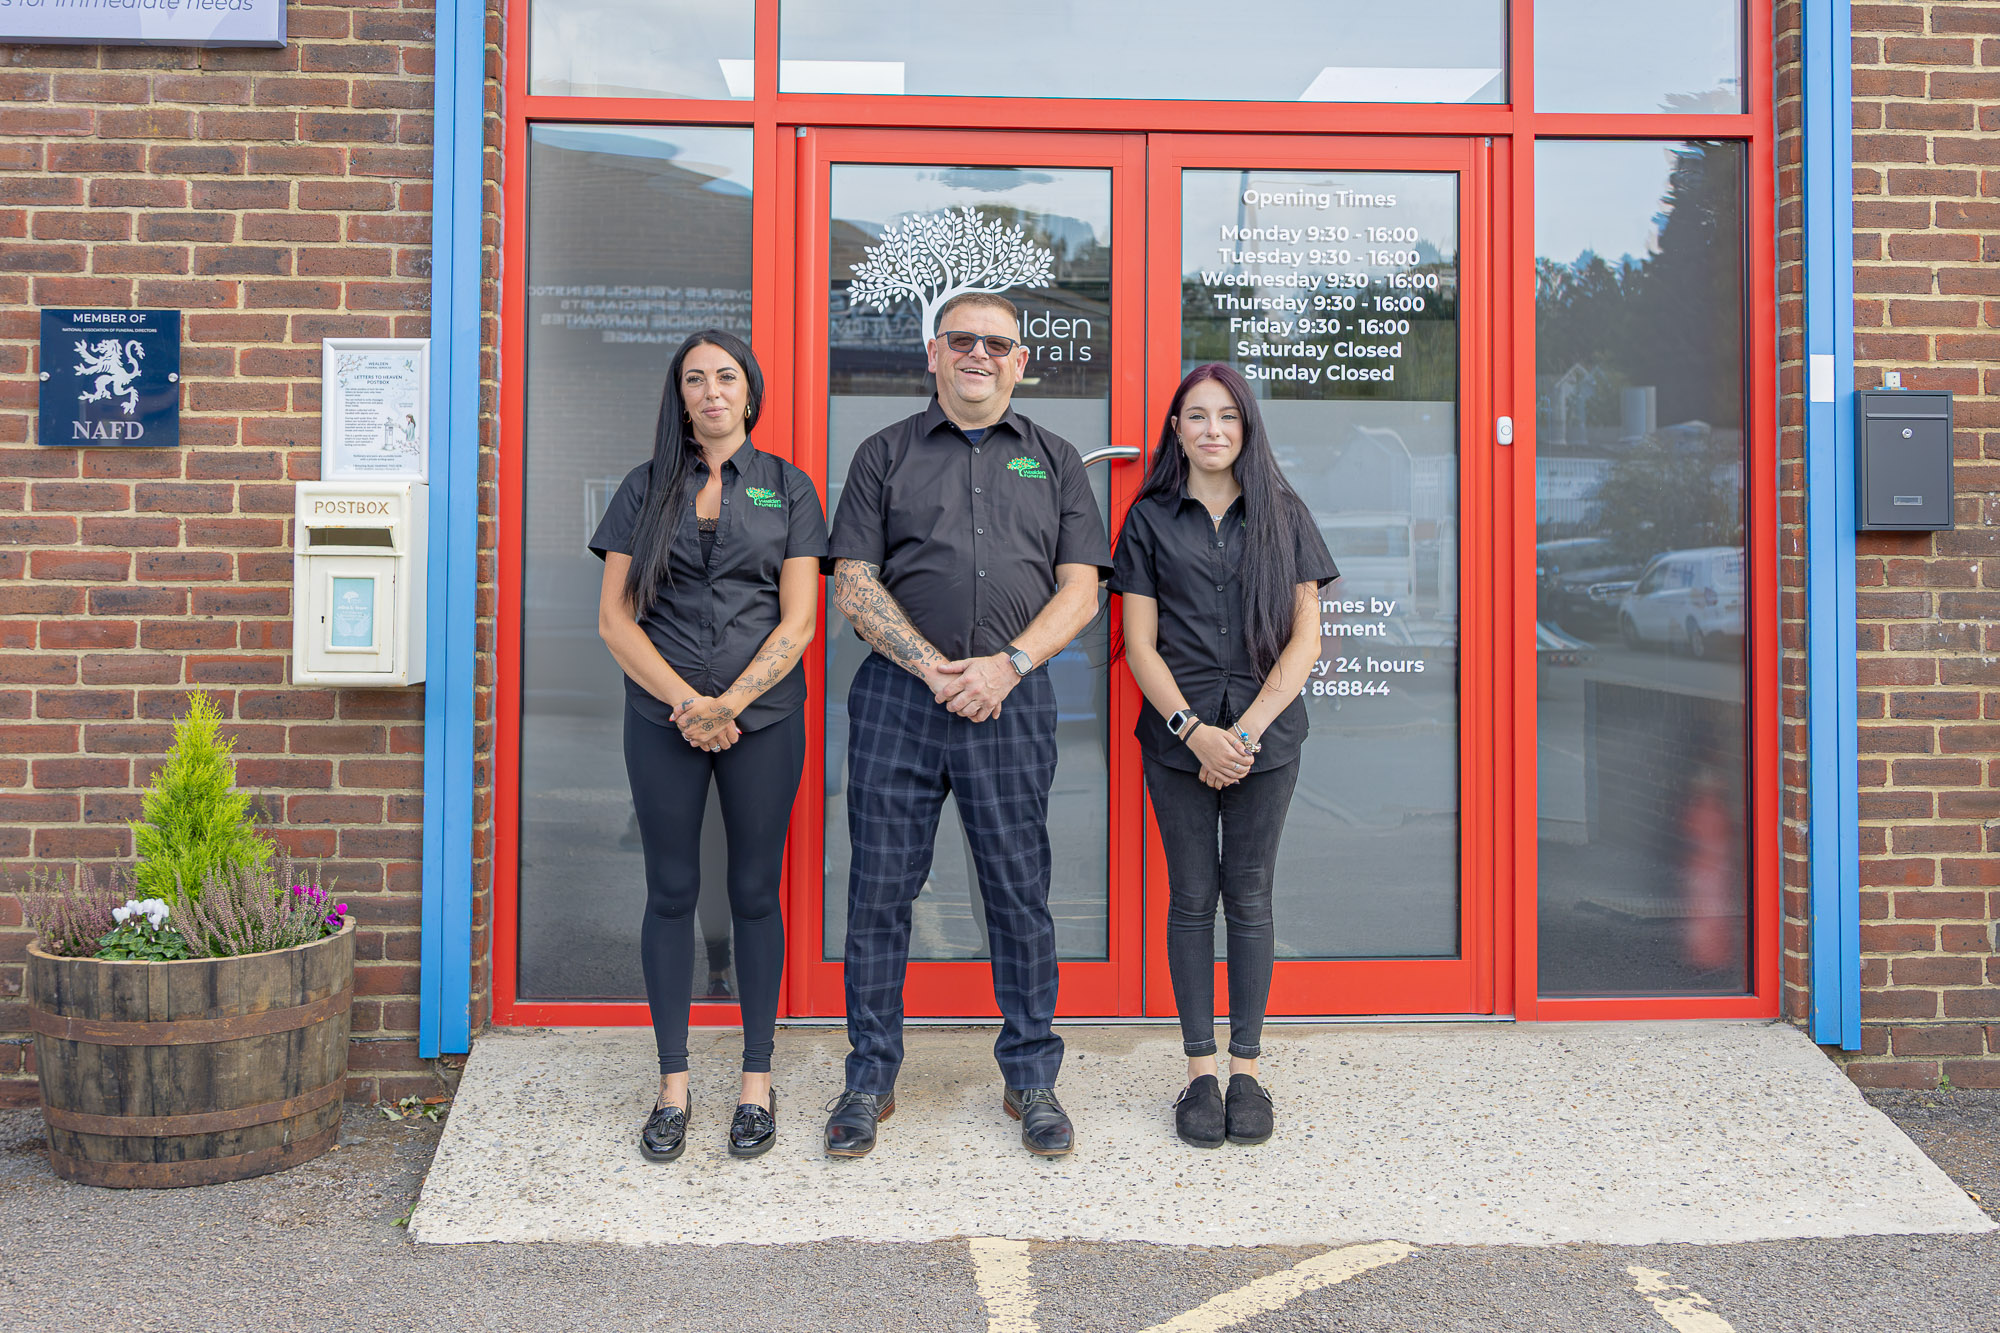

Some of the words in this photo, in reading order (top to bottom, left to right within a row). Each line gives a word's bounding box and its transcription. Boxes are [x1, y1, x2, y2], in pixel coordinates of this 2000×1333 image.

[1243, 189, 1331, 209] Opening
[1336, 190, 1397, 207] Times
[1221, 225, 1302, 244] Monday
[1308, 226, 1349, 241] 9:30
[1368, 227, 1419, 242] 16:00
[1219, 248, 1304, 267] Tuesday
[1309, 250, 1351, 264] 9:30
[1369, 250, 1421, 265] 16:00
[1201, 270, 1322, 291] Wednesday
[1327, 273, 1369, 288] 9:30
[1387, 273, 1439, 289] 16:00
[1213, 294, 1309, 314] Thursday
[1313, 296, 1356, 311] 9:30
[1373, 296, 1425, 311] 16:00
[73, 313, 127, 323] MEMBER
[129, 313, 147, 323] OF
[1016, 310, 1092, 339] lden
[1230, 317, 1293, 337] Friday
[1298, 319, 1340, 334] 9:30
[1358, 319, 1410, 335] 16:00
[1237, 341, 1329, 360] Saturday
[1334, 341, 1402, 358] Closed
[1245, 364, 1321, 384] Sunday
[1326, 365, 1395, 381] Closed
[71, 420, 144, 440] NAFD
[314, 500, 390, 515] POSTBOX
[1370, 597, 1396, 617] by
[1319, 622, 1386, 637] tment
[1335, 657, 1362, 673] 24
[1366, 656, 1425, 673] hours
[1311, 680, 1391, 696] 868844
